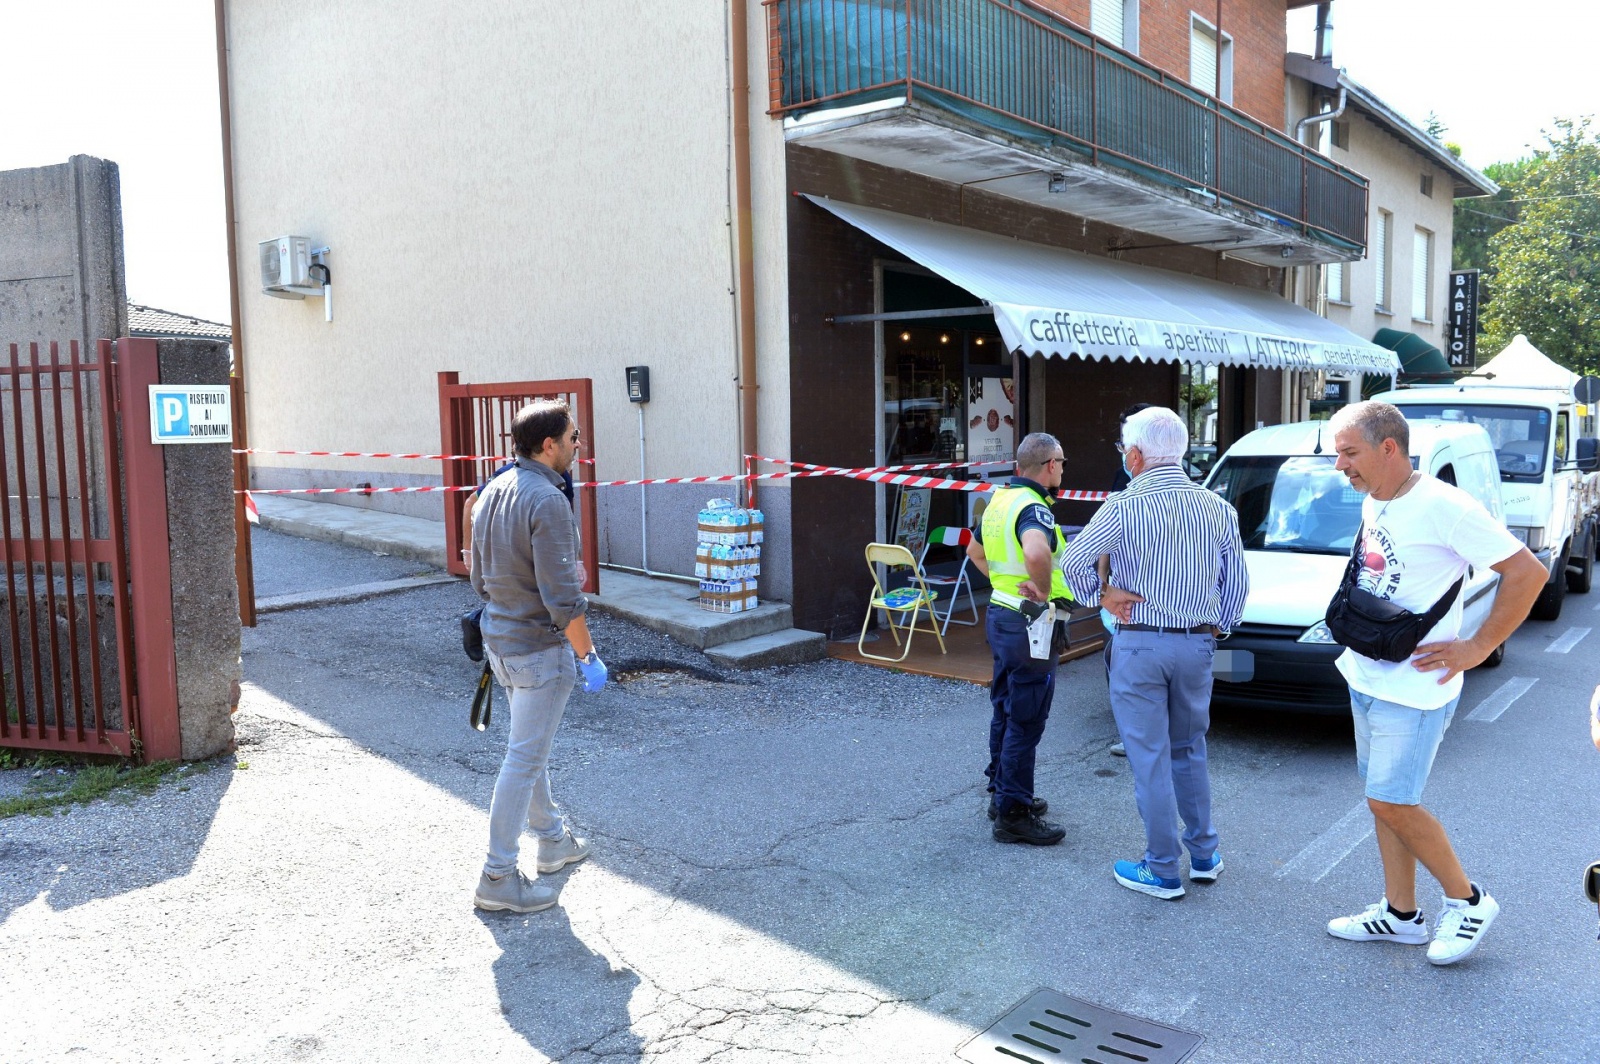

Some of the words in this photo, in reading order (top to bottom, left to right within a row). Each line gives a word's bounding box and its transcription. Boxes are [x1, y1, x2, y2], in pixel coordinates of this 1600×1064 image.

[1452, 275, 1465, 364] BABILON
[1030, 312, 1140, 347] caffetteria
[1162, 330, 1232, 357] aperitivi
[1244, 335, 1314, 366] LATTERIA
[1324, 348, 1354, 367] generi
[1353, 349, 1395, 368] alimentari
[190, 394, 225, 404] RISERVATO
[162, 397, 183, 432] P
[205, 409, 212, 420] AI
[190, 424, 228, 436] CONDOMINI
[1380, 572, 1401, 601] WEA
